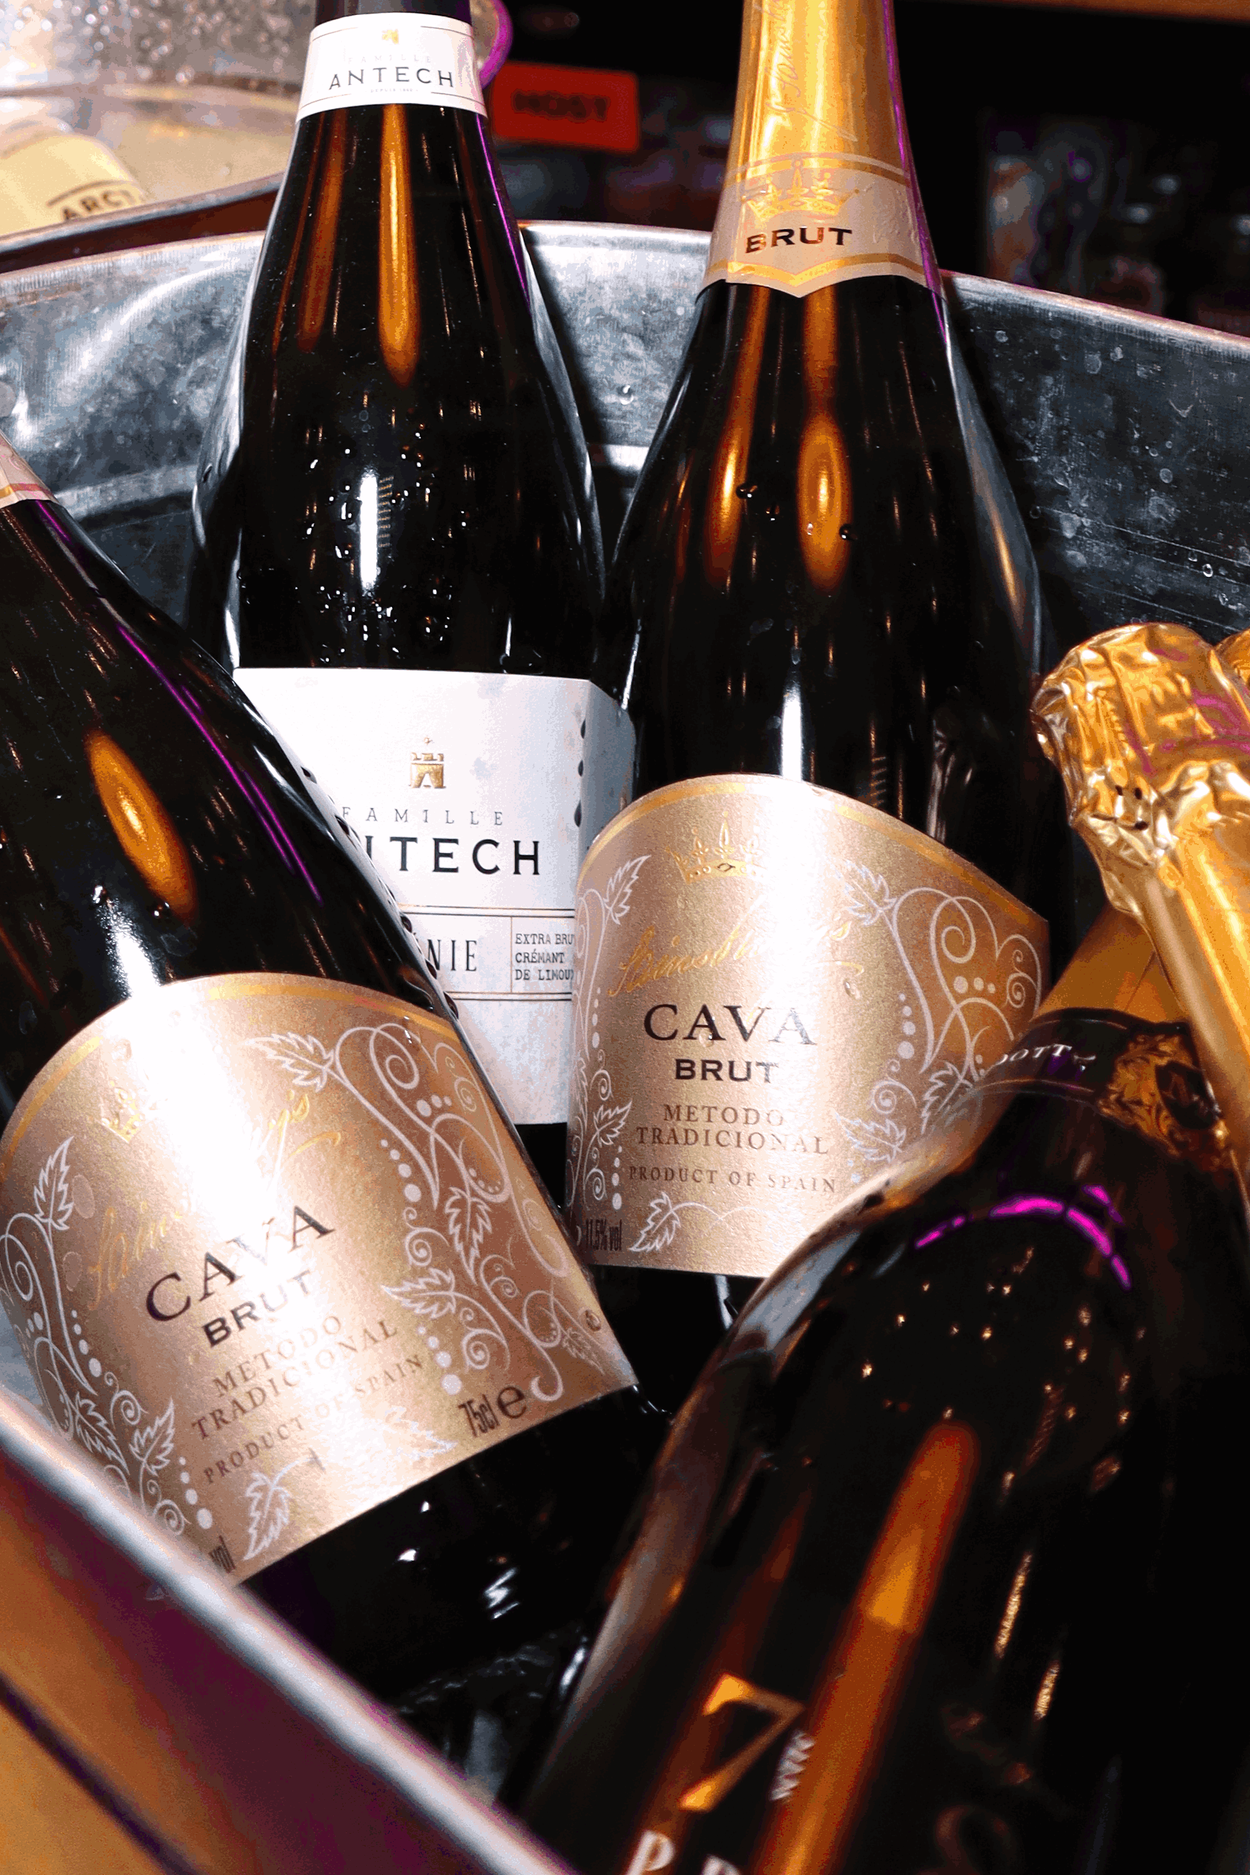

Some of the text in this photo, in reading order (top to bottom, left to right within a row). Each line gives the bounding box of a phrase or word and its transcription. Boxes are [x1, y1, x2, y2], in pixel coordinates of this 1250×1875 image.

[329, 66, 454, 91] ANTECH
[745, 226, 853, 254] BRUT
[341, 806, 504, 826] FAMILLE
[414, 933, 478, 973] NIE
[514, 933, 552, 945] EXTRA
[514, 948, 565, 964] CRÉMANT
[514, 969, 531, 981] DE
[643, 1003, 818, 1045] CAVA
[674, 1058, 780, 1083] BRUT
[663, 1103, 786, 1127] METODO
[636, 1126, 830, 1156] TRADICIONAL
[628, 1165, 837, 1194] PRODUCT OF SPAIN
[145, 1204, 337, 1323] CAVA
[200, 1270, 312, 1348] BRUT
[212, 1315, 342, 1399] METODO
[191, 1319, 398, 1441] TRADICIONAL
[202, 1353, 423, 1485] PRODUCT OF SPAIN
